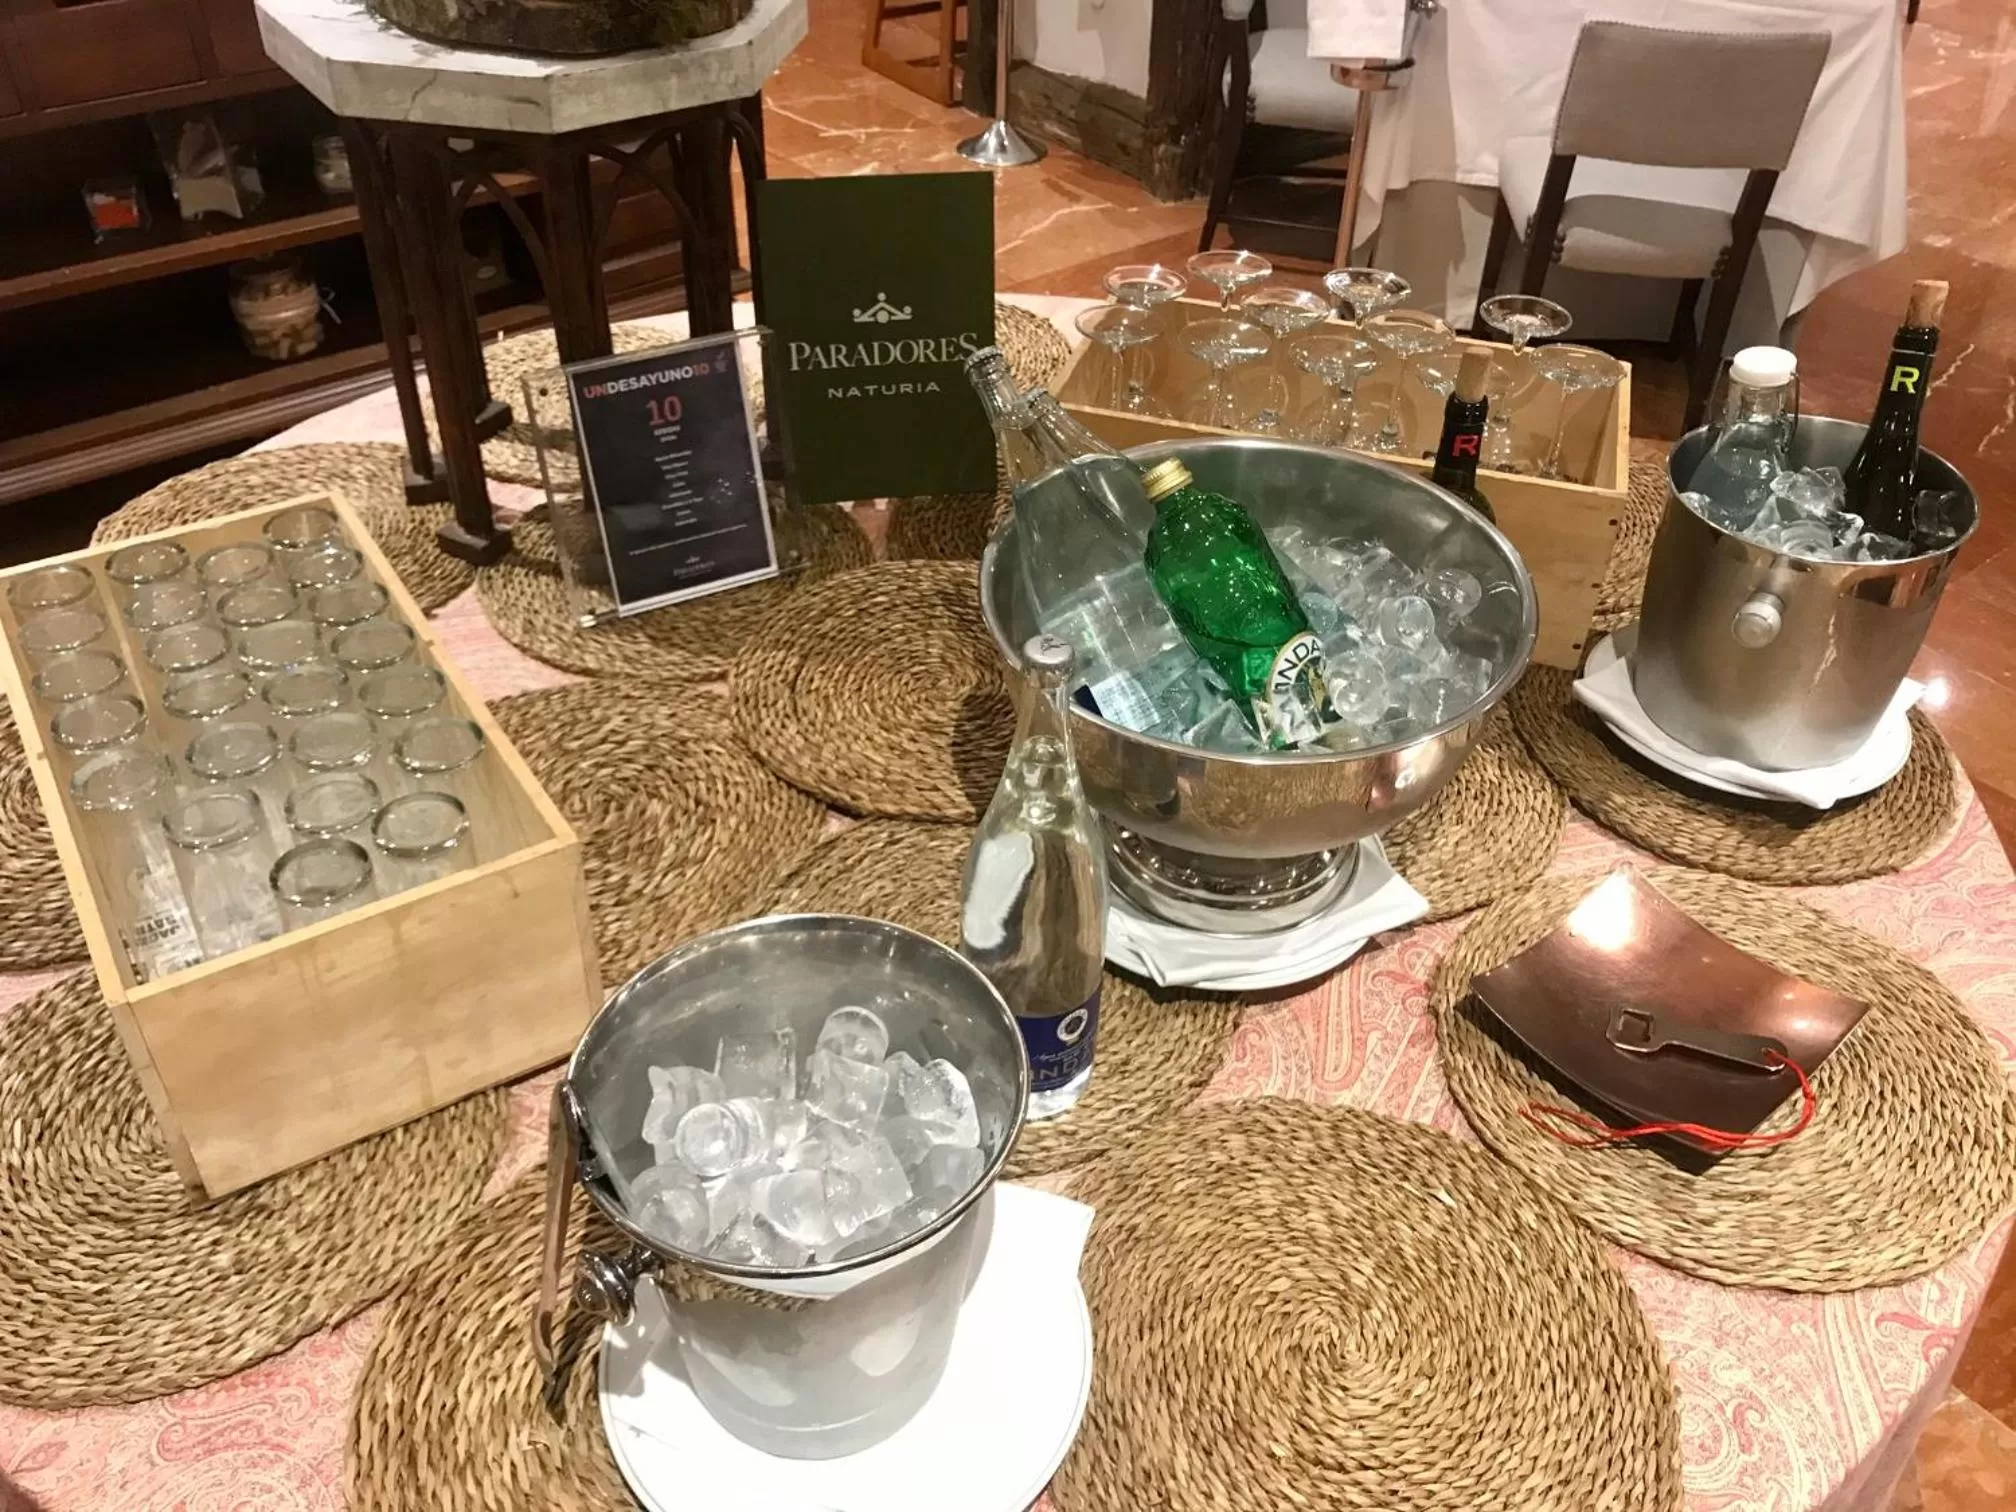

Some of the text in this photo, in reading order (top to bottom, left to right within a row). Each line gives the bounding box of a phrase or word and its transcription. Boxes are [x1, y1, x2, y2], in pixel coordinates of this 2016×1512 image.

[787, 332, 979, 371] PARADORES
[827, 381, 941, 399] NATURIA
[1890, 365, 1920, 395] R
[645, 395, 683, 426] 10
[1451, 434, 1480, 457] R
